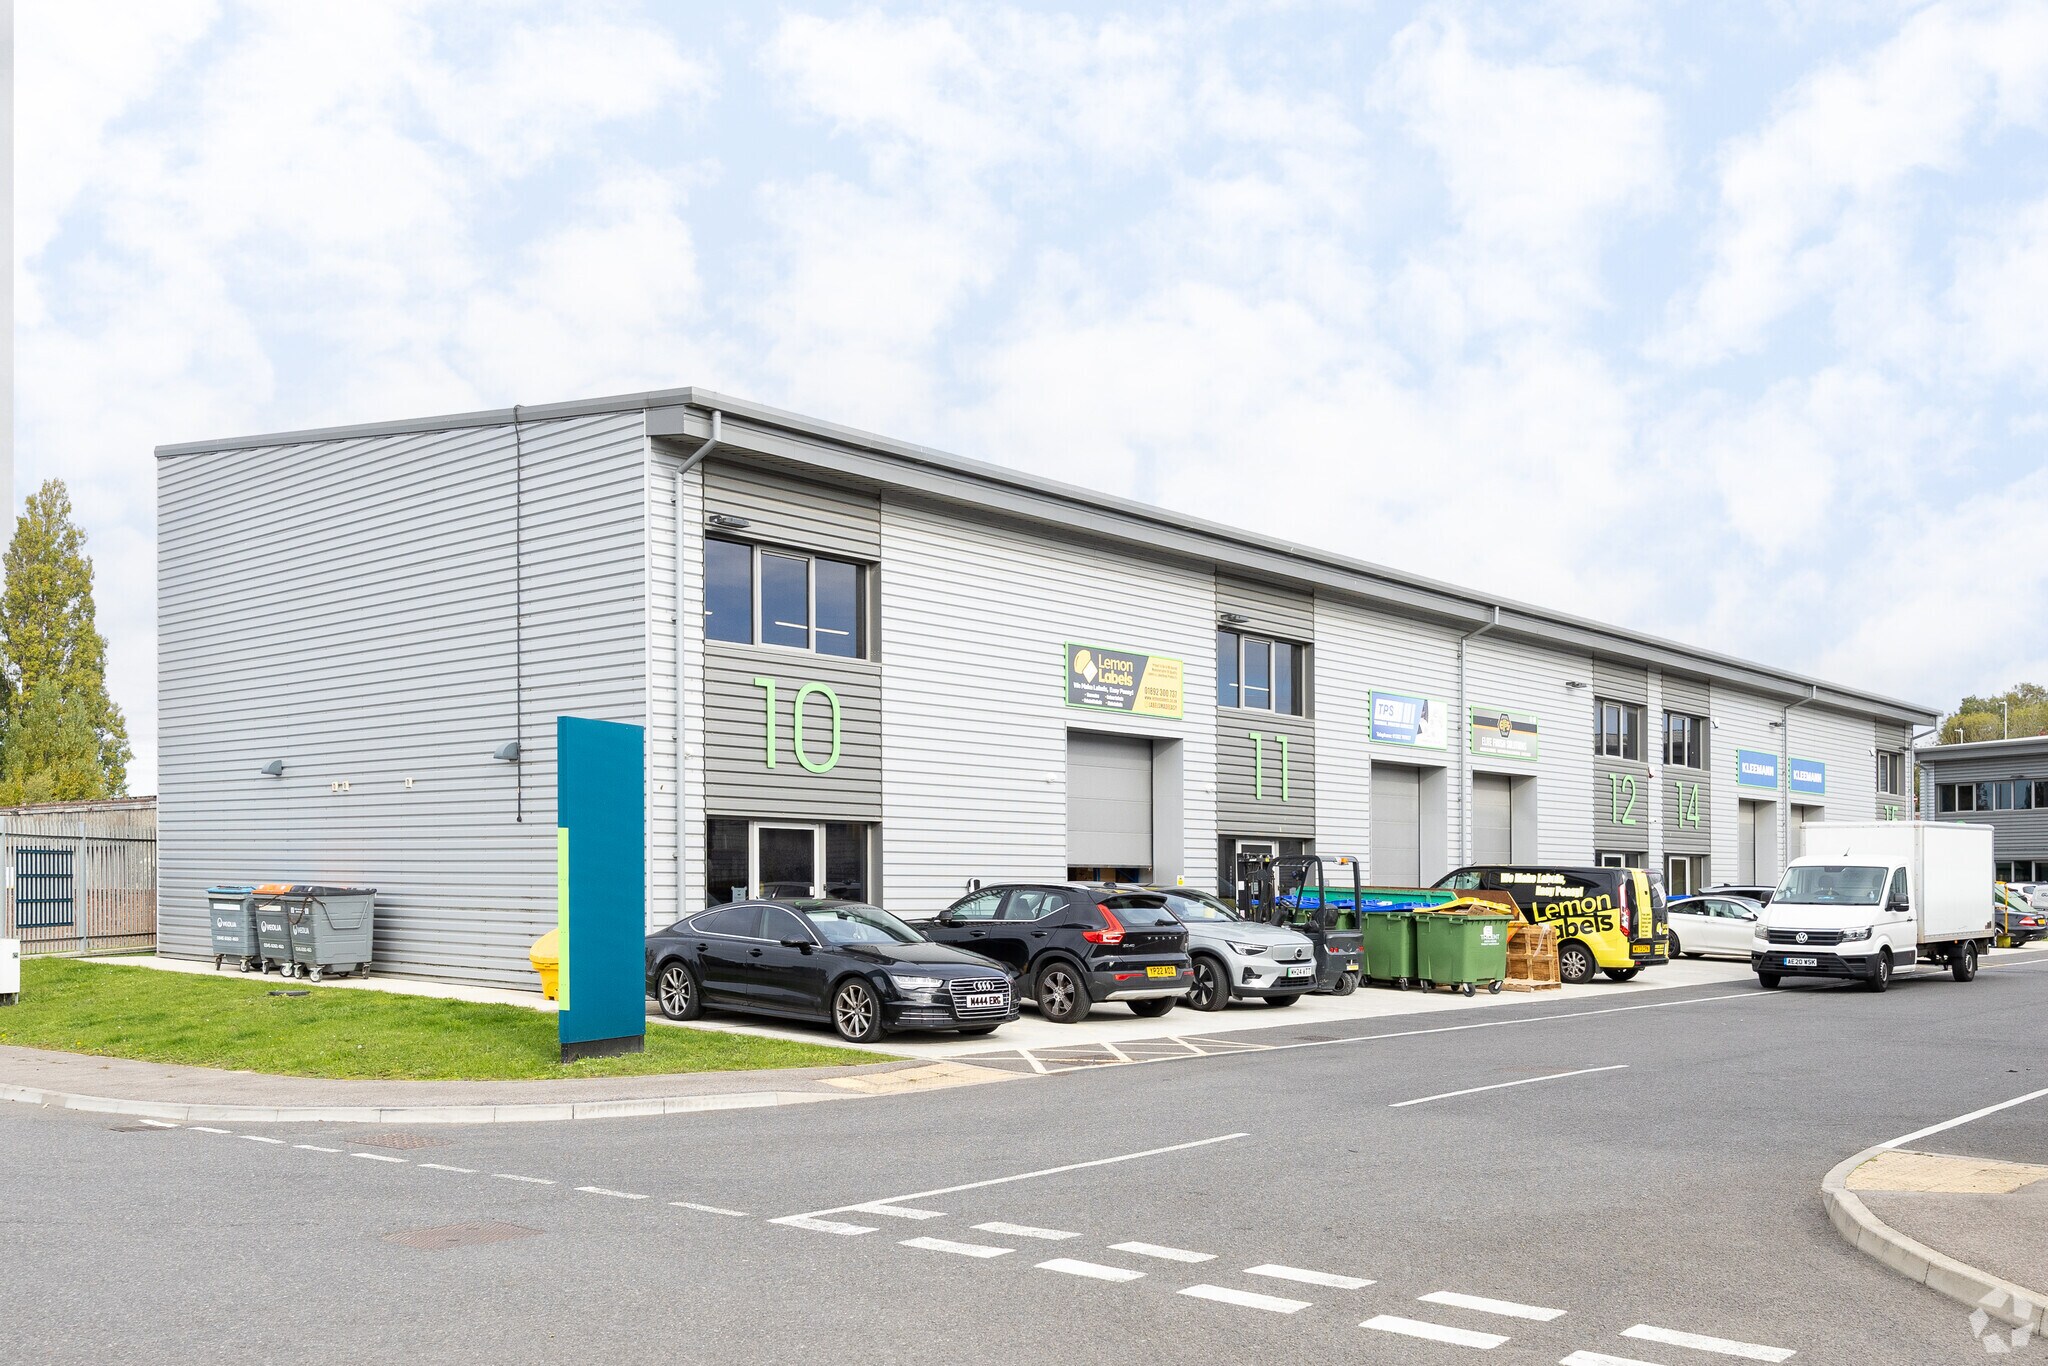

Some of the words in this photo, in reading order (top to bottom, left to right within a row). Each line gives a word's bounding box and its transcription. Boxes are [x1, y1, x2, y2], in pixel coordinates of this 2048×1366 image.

[1098, 654, 1133, 672] Lemon
[1098, 668, 1133, 687] Labels
[1378, 703, 1394, 717] TPS
[754, 677, 840, 774] 10
[1249, 732, 1288, 802] 11
[1741, 762, 1774, 777] KLEEMANN
[1793, 769, 1822, 783] KLEEMANN
[1608, 773, 1637, 825] 12
[1675, 781, 1700, 830] 14
[1532, 894, 1612, 922] Lemon
[266, 924, 282, 932] VEOLIA
[1555, 914, 1613, 938] abels
[1150, 966, 1164, 975] YP22
